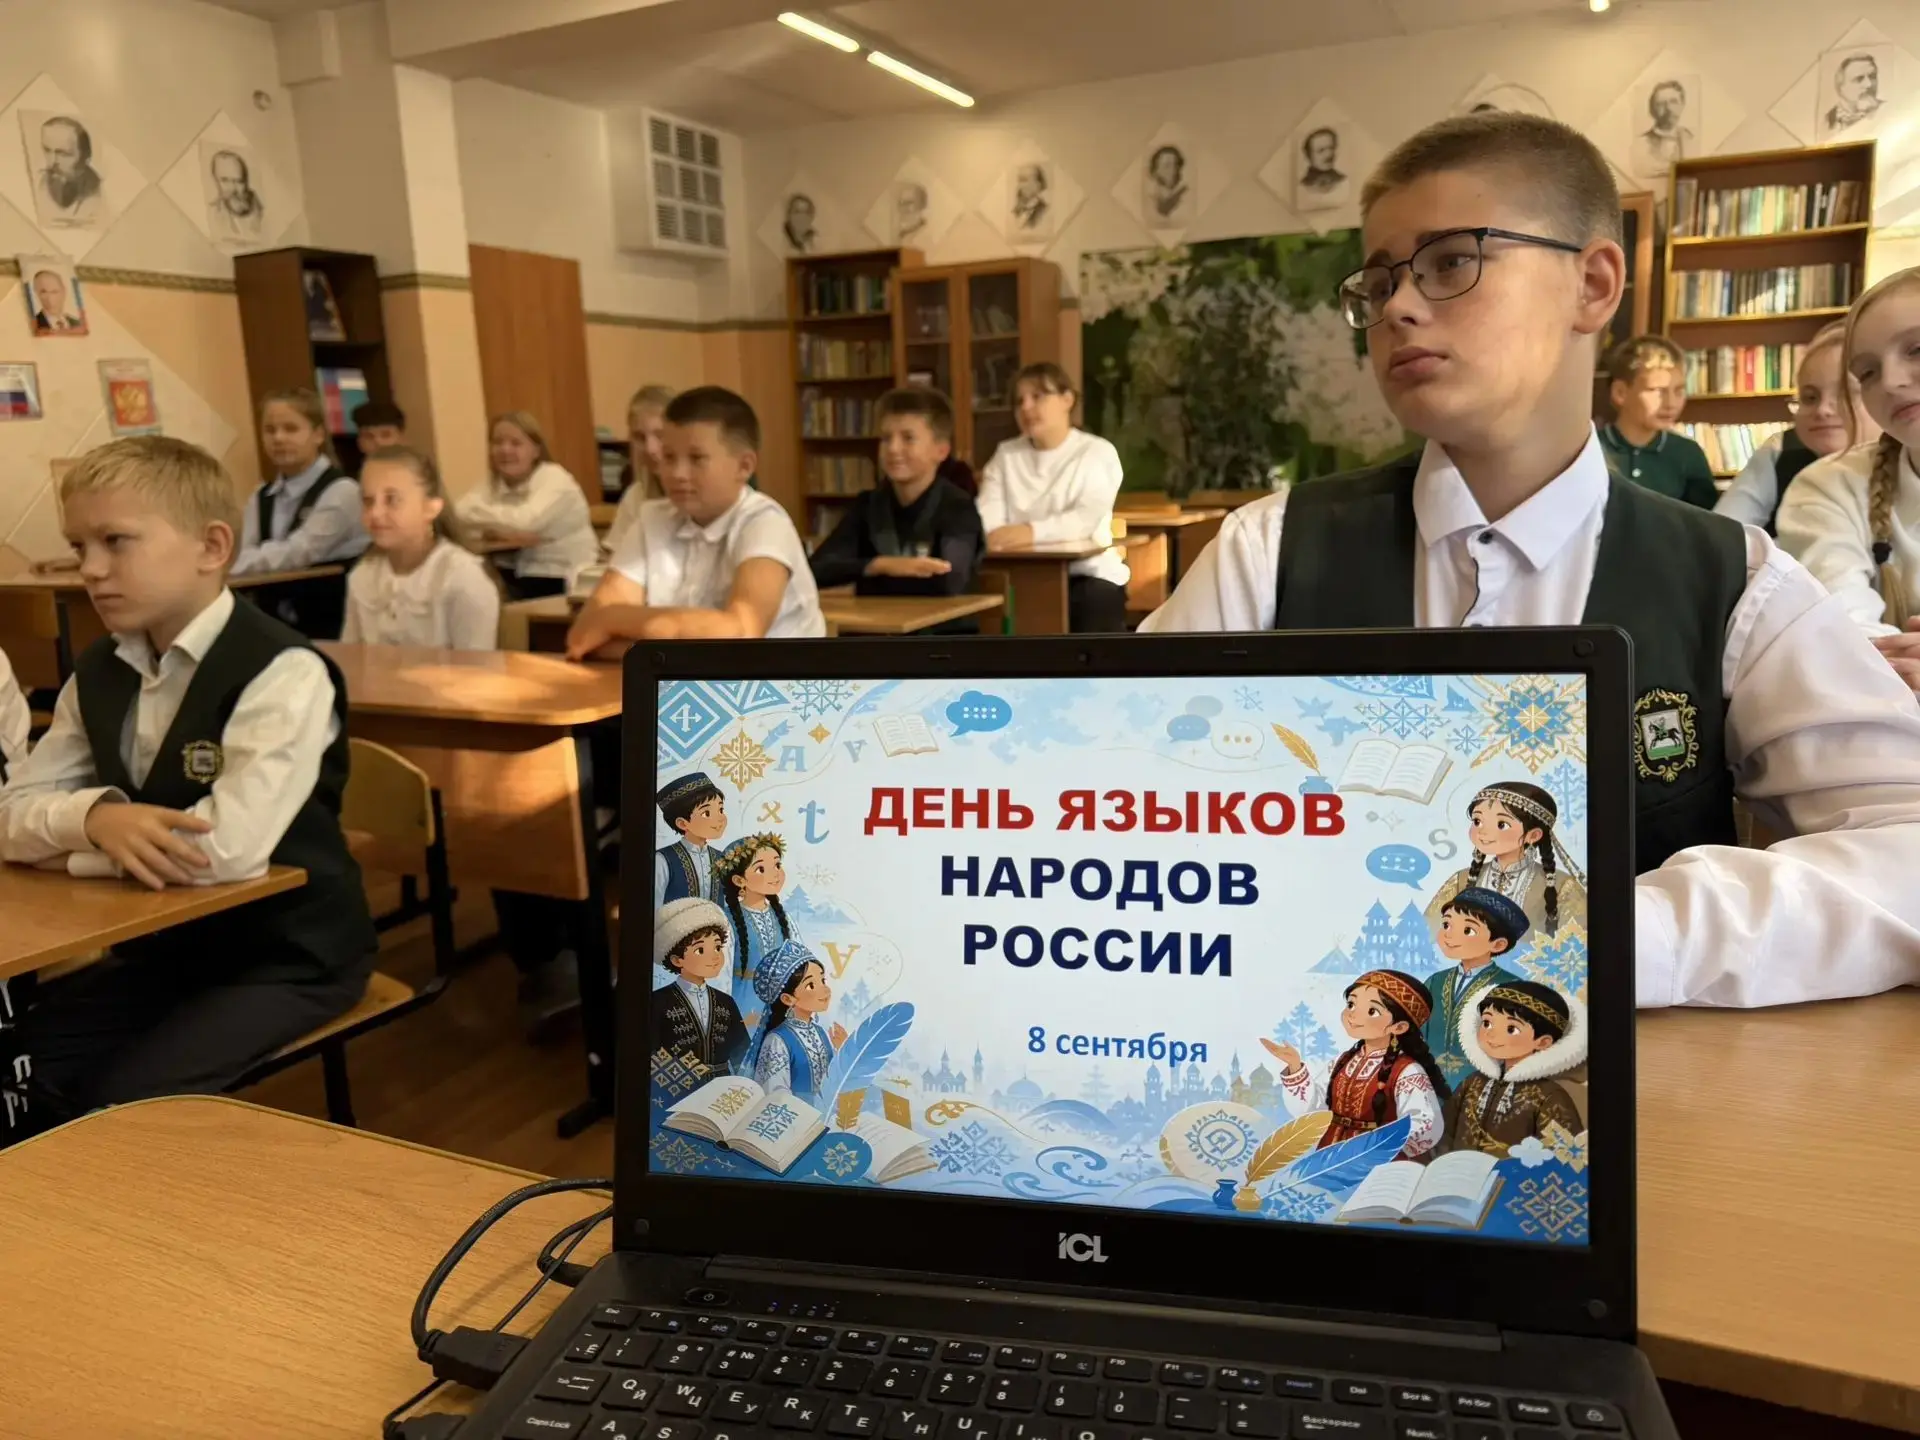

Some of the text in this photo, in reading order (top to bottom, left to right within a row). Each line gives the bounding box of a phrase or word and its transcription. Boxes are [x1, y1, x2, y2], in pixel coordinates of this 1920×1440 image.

[863, 787, 1346, 836] ДЕНЬ ЯЗЫКОВ
[941, 855, 1260, 911] НАРОДОВ
[963, 924, 1232, 977] РОССИИ
[1028, 1026, 1207, 1068] 8 сентября
[669, 1355, 680, 1363] 2
[1110, 1358, 1126, 1366] F10
[719, 1361, 729, 1369] 3
[1165, 1363, 1180, 1371] F11
[773, 1367, 783, 1375] 4
[825, 1372, 836, 1380] 5
[1221, 1368, 1238, 1377] F12
[622, 1379, 637, 1390] Q
[884, 1378, 895, 1388] 6
[940, 1384, 950, 1393] 7
[676, 1384, 696, 1396] W
[996, 1391, 1007, 1400] 8
[687, 1396, 702, 1407] Ц
[729, 1391, 744, 1403] E
[1054, 1397, 1065, 1406] 9
[783, 1397, 800, 1409] R
[844, 1404, 857, 1416] T
[901, 1411, 916, 1423] Y
[1302, 1414, 1361, 1429] Backspace
[601, 1420, 616, 1431] A
[957, 1417, 973, 1430] U
[657, 1427, 672, 1439] S
